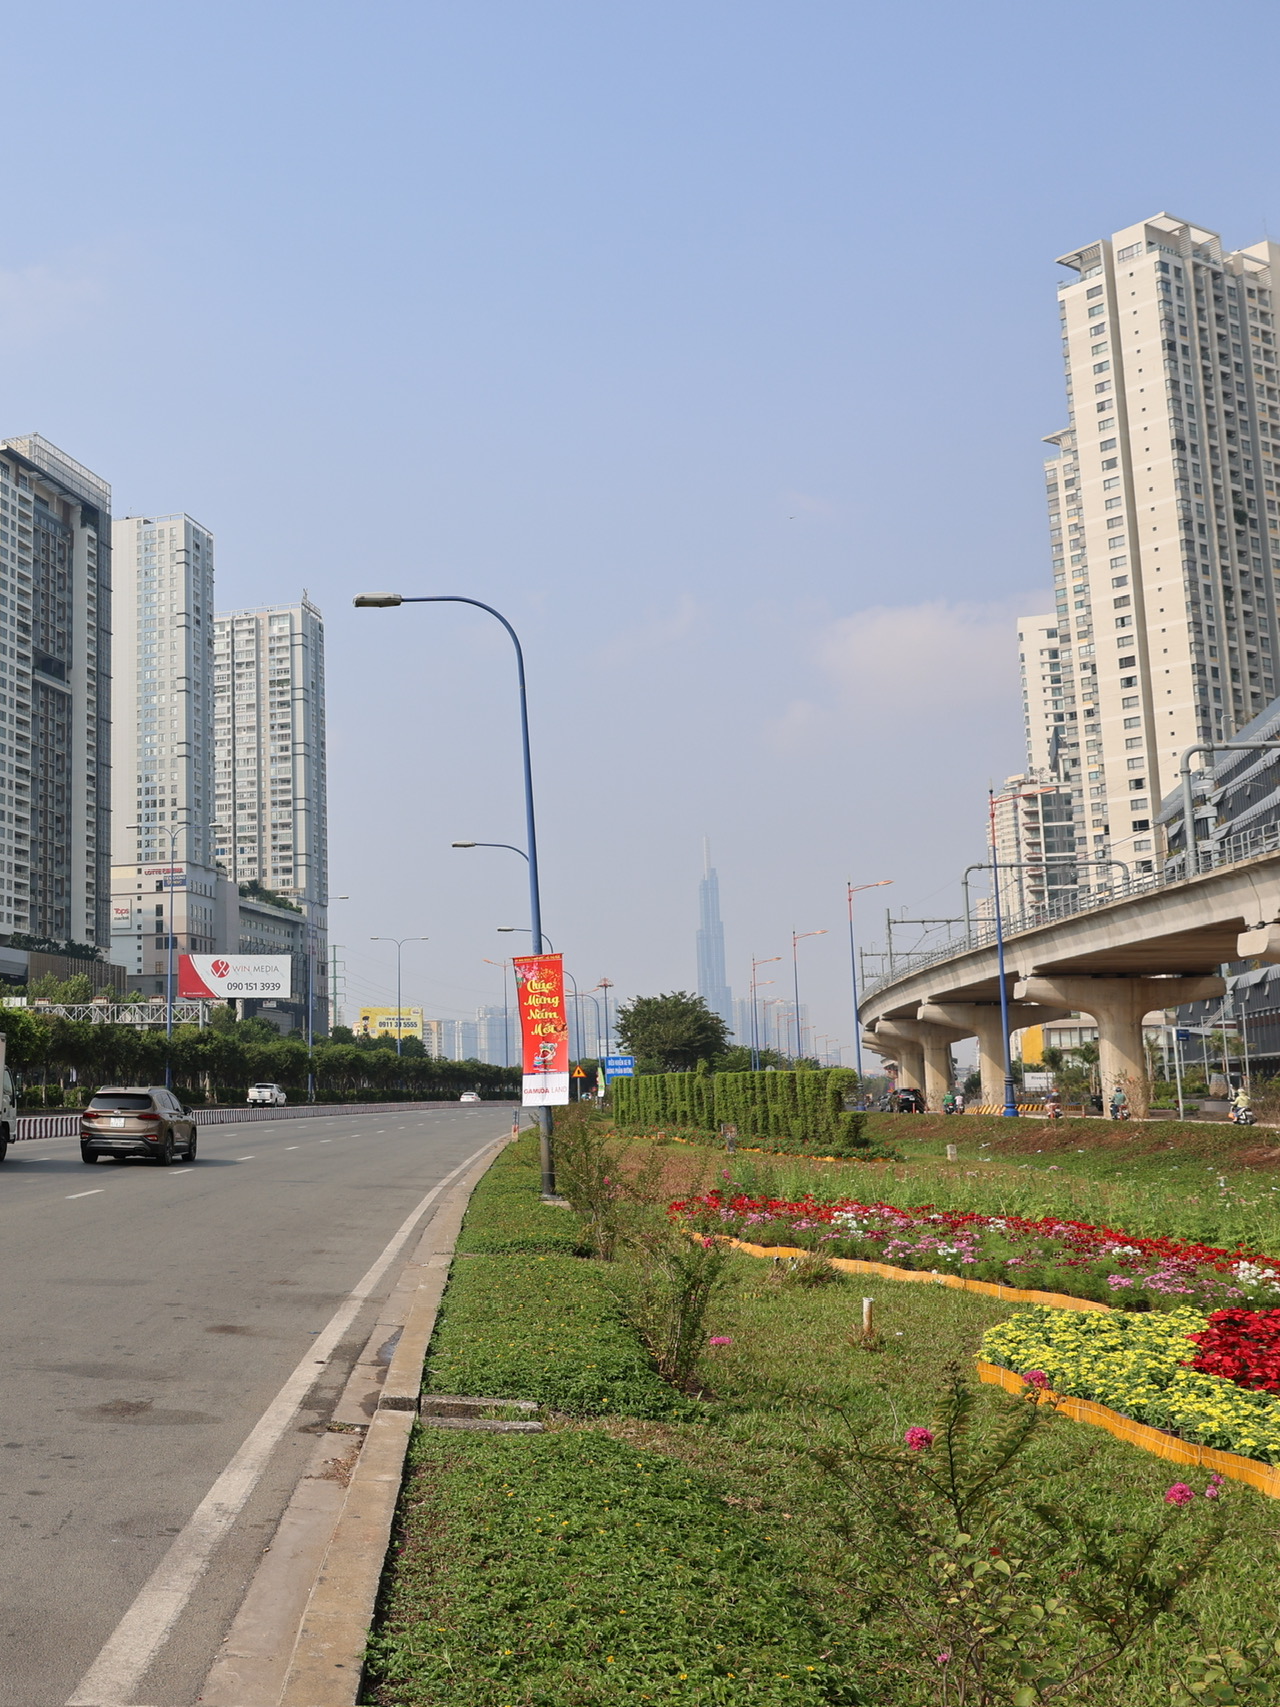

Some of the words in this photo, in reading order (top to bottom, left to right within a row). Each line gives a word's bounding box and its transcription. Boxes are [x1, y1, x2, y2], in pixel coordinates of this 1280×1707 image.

[114, 908, 129, 916] Tops
[253, 965, 280, 973] MEDIA
[227, 982, 243, 991] 090
[245, 982, 258, 991] 151
[260, 982, 281, 991] 3939
[527, 980, 553, 993] Chúc
[524, 994, 560, 1007] Mừng
[551, 1086, 568, 1094] LAND
